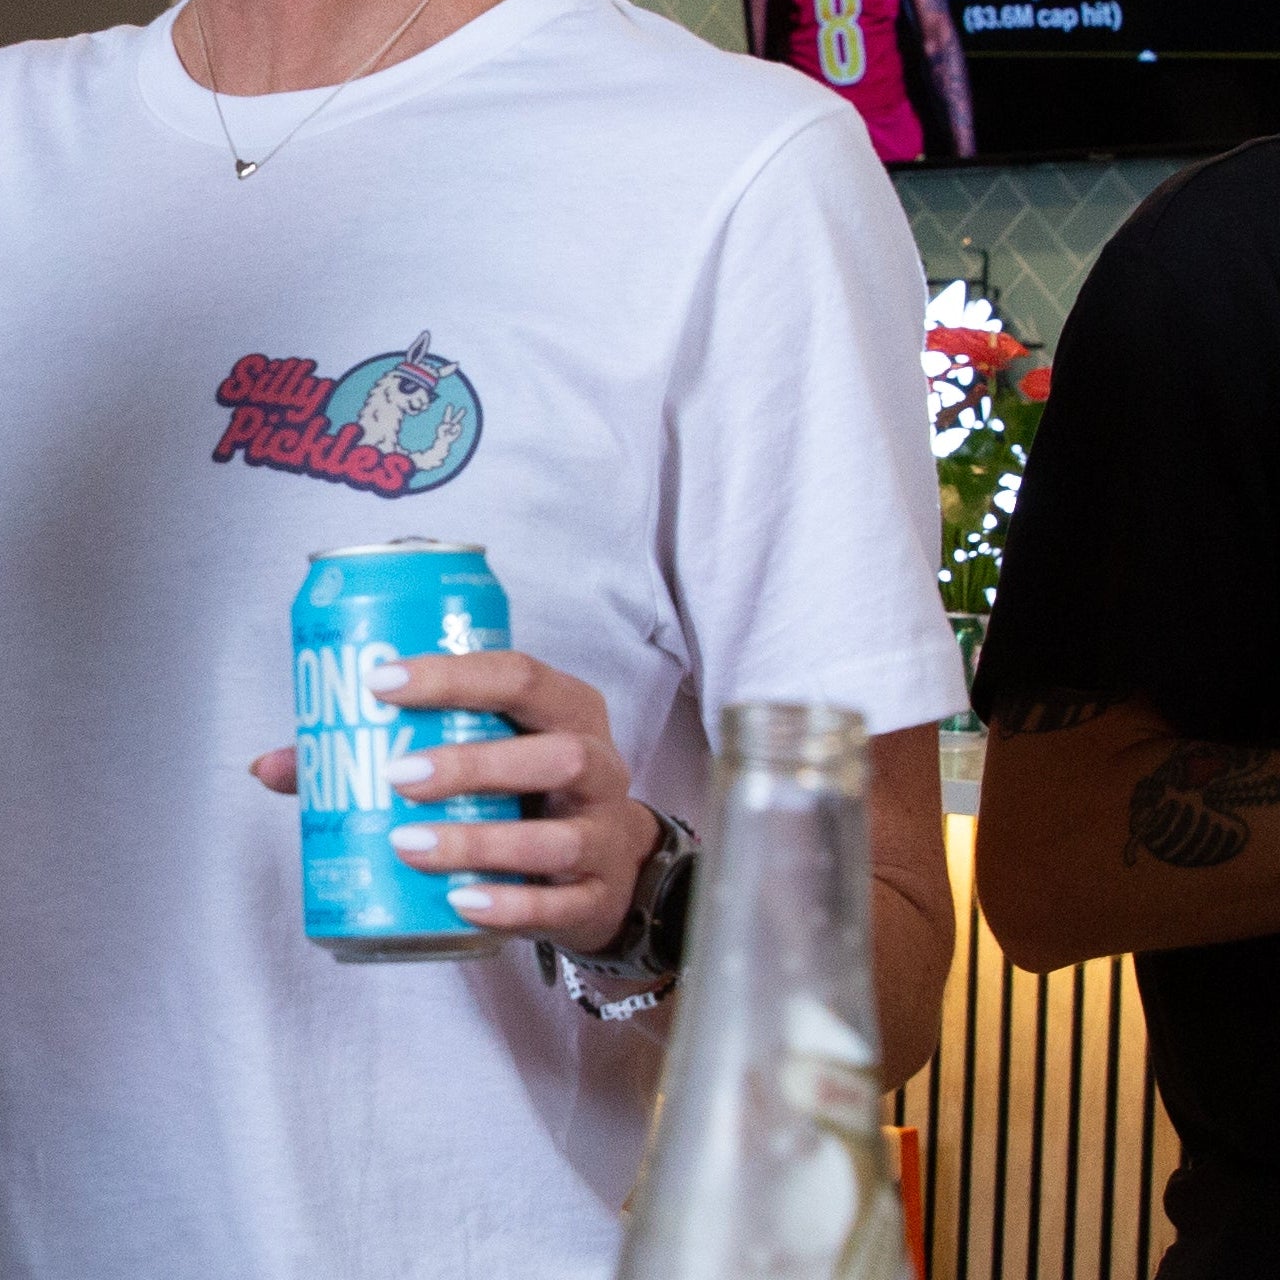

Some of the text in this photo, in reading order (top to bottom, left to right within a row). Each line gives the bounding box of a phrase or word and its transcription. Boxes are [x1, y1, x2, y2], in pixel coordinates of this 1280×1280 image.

[1037, 7, 1079, 33] cap
[1081, 0, 1123, 32] hit)
[217, 353, 336, 423] Silly
[213, 405, 414, 497] Pickles
